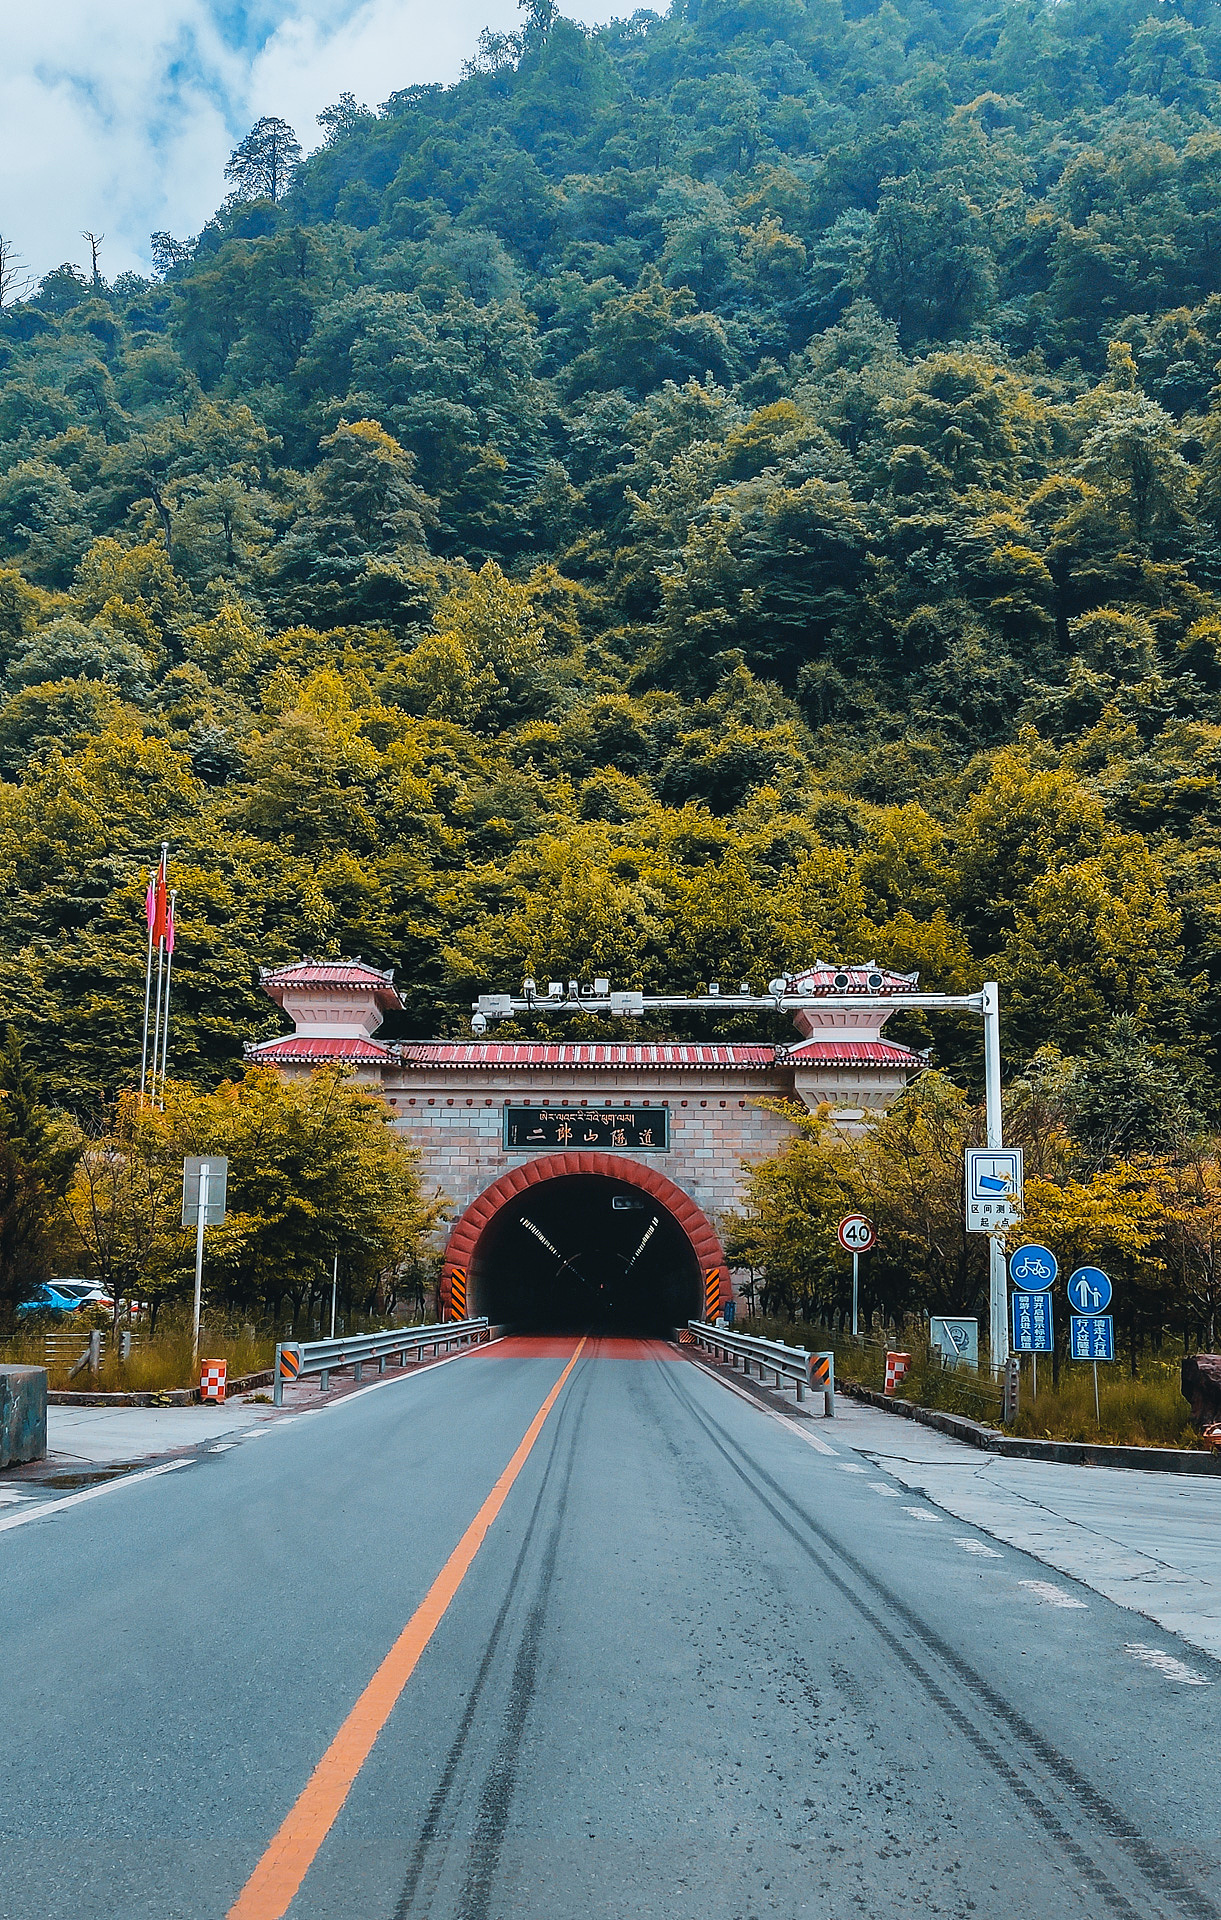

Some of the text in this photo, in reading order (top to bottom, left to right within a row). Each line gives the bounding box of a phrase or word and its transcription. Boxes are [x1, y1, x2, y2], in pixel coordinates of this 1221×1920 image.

[526, 1121, 656, 1147] 二郎山隧道
[845, 1225, 870, 1242] 40
[980, 1217, 1010, 1227] 起点
[1018, 1295, 1032, 1349] 骑游人员进入隧道
[1033, 1295, 1046, 1349] 请开启警示标志灯
[1076, 1318, 1090, 1357] 行人过隧道
[1092, 1319, 1107, 1357] 请走人行道
